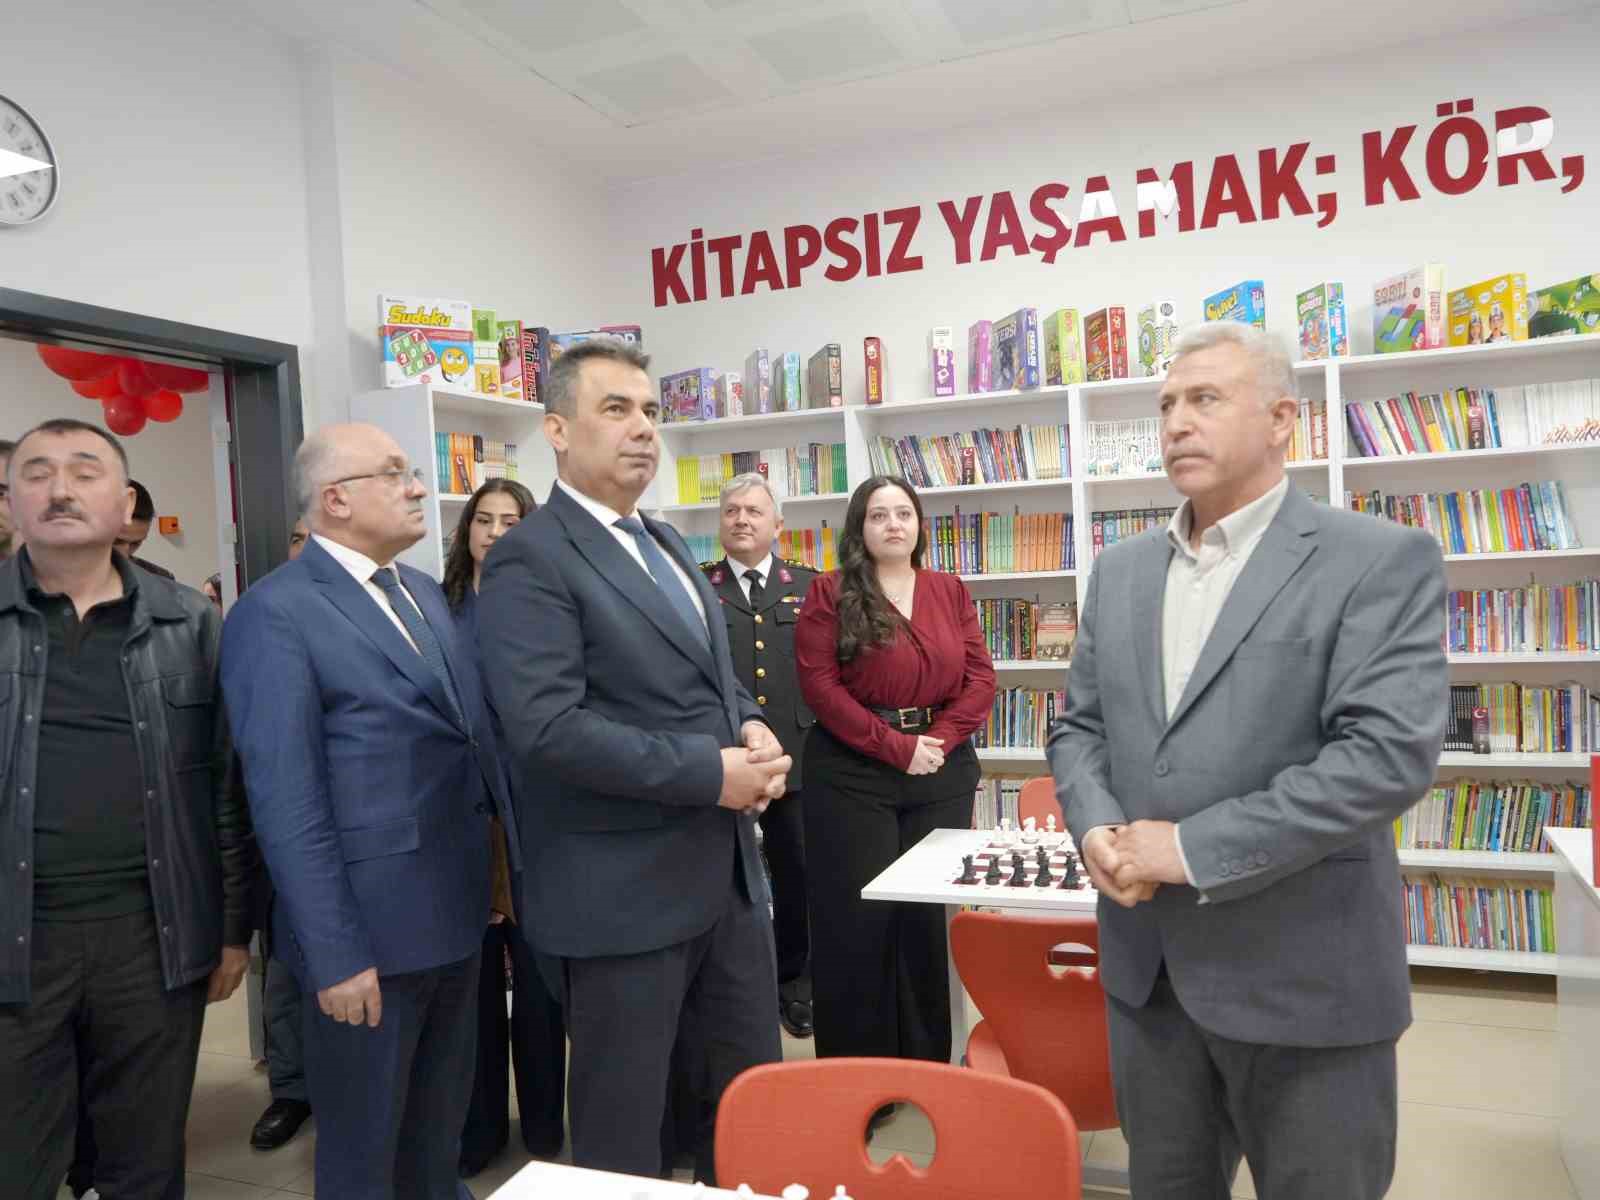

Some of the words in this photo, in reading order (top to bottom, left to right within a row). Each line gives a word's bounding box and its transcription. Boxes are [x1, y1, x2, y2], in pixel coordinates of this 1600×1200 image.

[651, 207, 924, 308] KİTAPSIZ
[937, 141, 1339, 264] YAŞAMAK;
[1361, 97, 1586, 207] KÖR,
[387, 304, 452, 327] Sudoku
